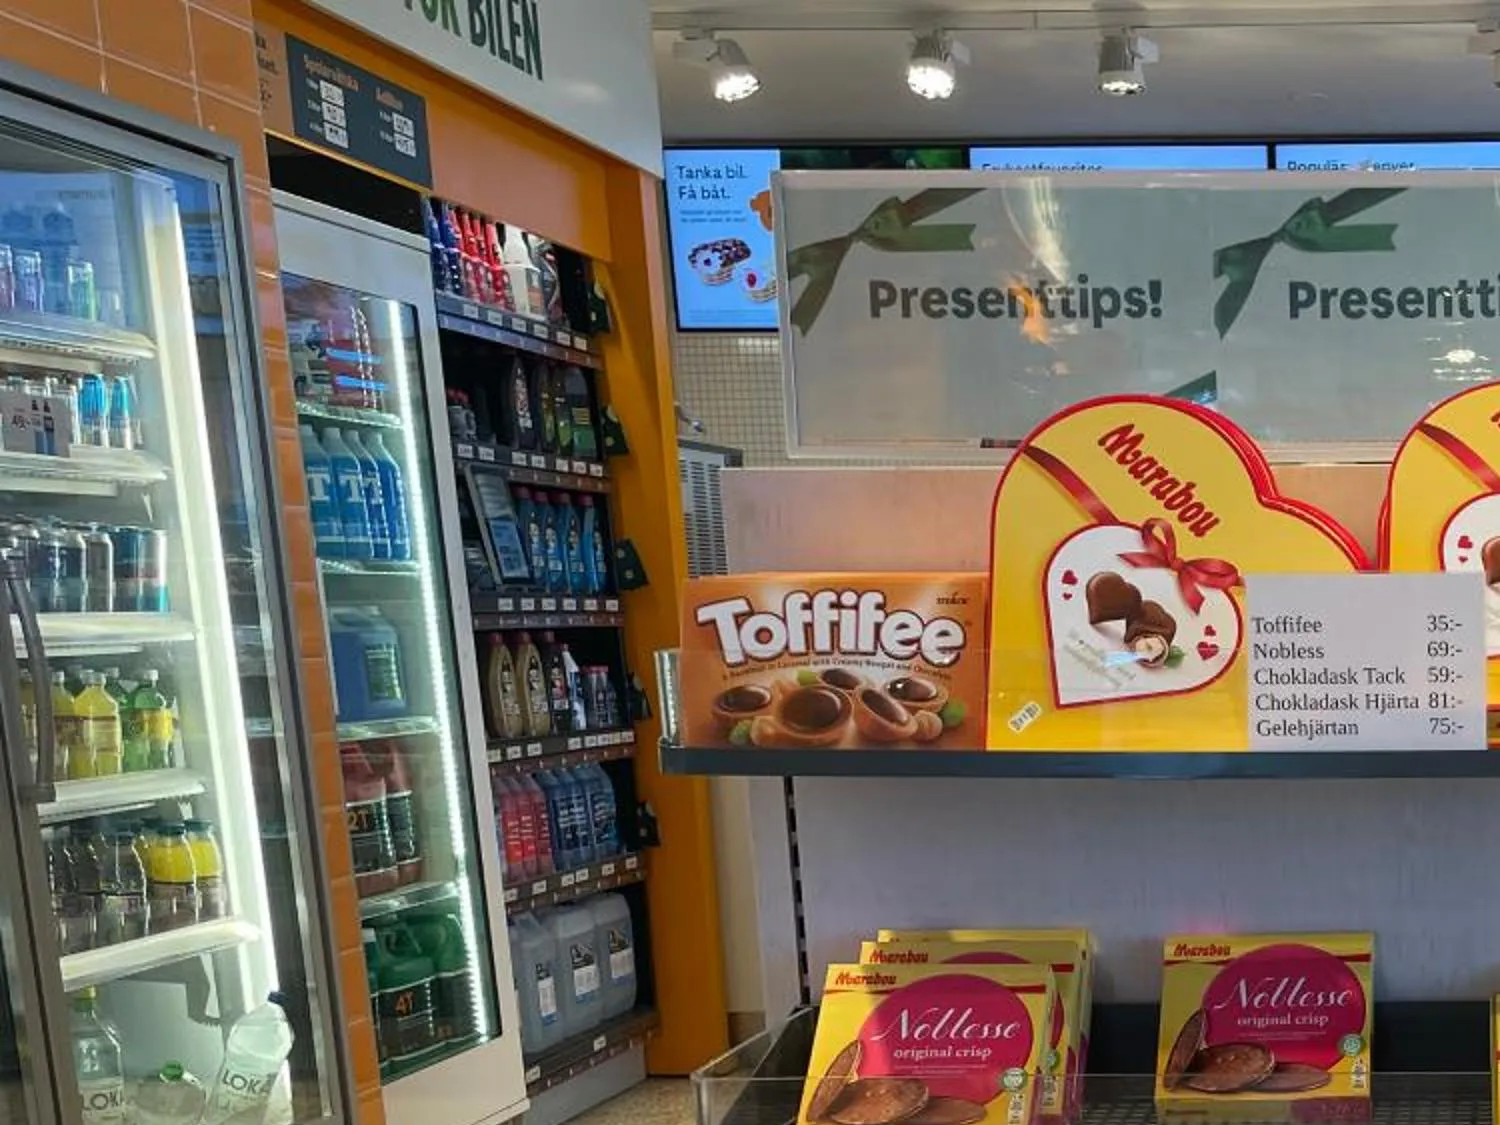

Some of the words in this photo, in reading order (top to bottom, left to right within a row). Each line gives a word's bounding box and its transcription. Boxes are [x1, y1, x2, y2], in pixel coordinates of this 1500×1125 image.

[467, 0, 543, 80] BILEN
[676, 165, 722, 180] Tanka
[725, 163, 748, 179] bil.
[679, 183, 698, 200] Få
[702, 183, 731, 199] båt.
[869, 275, 1162, 328] Presenttips!
[1097, 423, 1221, 538] Marabou
[696, 590, 966, 667] Toffifee
[1252, 615, 1323, 634] Toffifee
[1426, 614, 1463, 632] 35:-
[1252, 641, 1325, 660] Nobless
[1427, 640, 1463, 658] 69:-
[1254, 668, 1358, 686] Chokladask
[1363, 666, 1406, 685] Tack
[1427, 665, 1463, 684] 59:-
[1255, 693, 1359, 711] Chokladask
[1364, 693, 1419, 715] Hjärta
[1428, 691, 1463, 709] 81:-
[1256, 719, 1359, 741] Gelehjärtan
[1429, 717, 1464, 735] 75:-
[869, 949, 929, 964] Marabou
[1173, 943, 1231, 957] Marabou
[835, 971, 897, 985] Marabou
[1213, 976, 1353, 1009] Noblesse
[870, 1007, 1020, 1041] Noblesse
[1237, 1013, 1291, 1028] original
[1295, 1014, 1329, 1027] crisp
[893, 1045, 951, 1061] original
[955, 1046, 991, 1061] crisp
